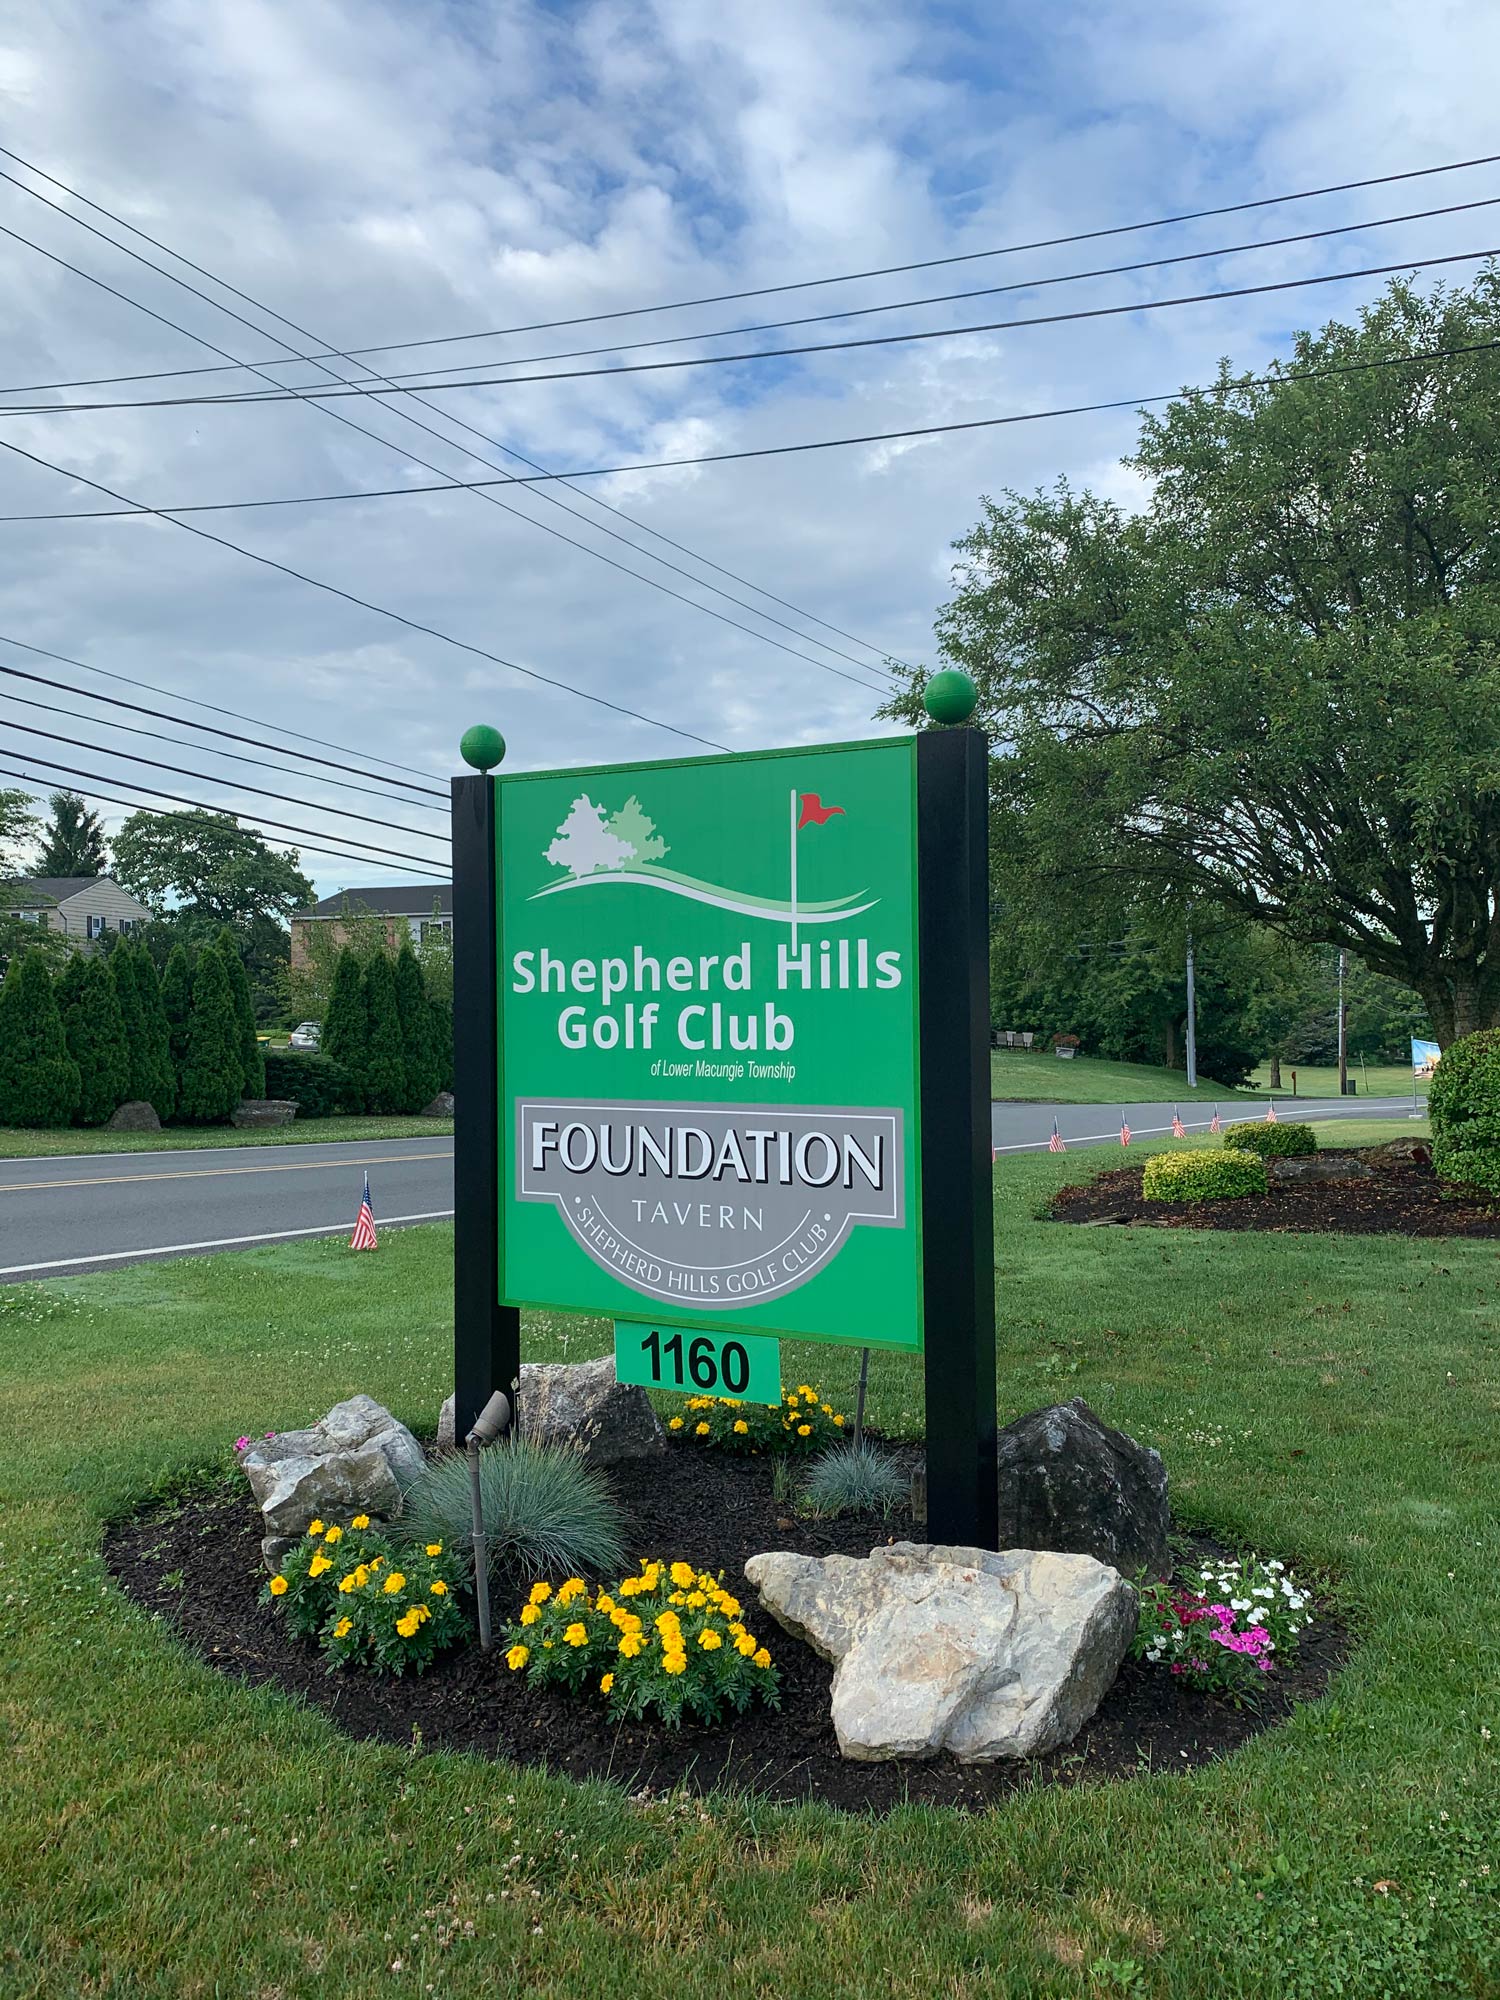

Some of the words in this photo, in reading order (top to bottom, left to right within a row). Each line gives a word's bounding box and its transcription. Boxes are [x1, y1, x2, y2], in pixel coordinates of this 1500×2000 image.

[512, 942, 752, 1006] Shepherd
[777, 938, 902, 990] Hills
[557, 1003, 660, 1050] Golf
[677, 1002, 795, 1051] Club
[651, 1060, 661, 1077] of
[663, 1061, 694, 1078] Lower
[695, 1062, 744, 1081] Macungie
[747, 1063, 796, 1083] Township
[532, 1121, 884, 1191] FOUNDATION
[632, 1200, 764, 1232] TAVERN
[577, 1207, 662, 1283] SHEPHERD
[668, 1270, 720, 1294] HILLS
[726, 1262, 778, 1293] GOLF
[781, 1223, 829, 1274] CLUB
[641, 1330, 750, 1394] 1160
